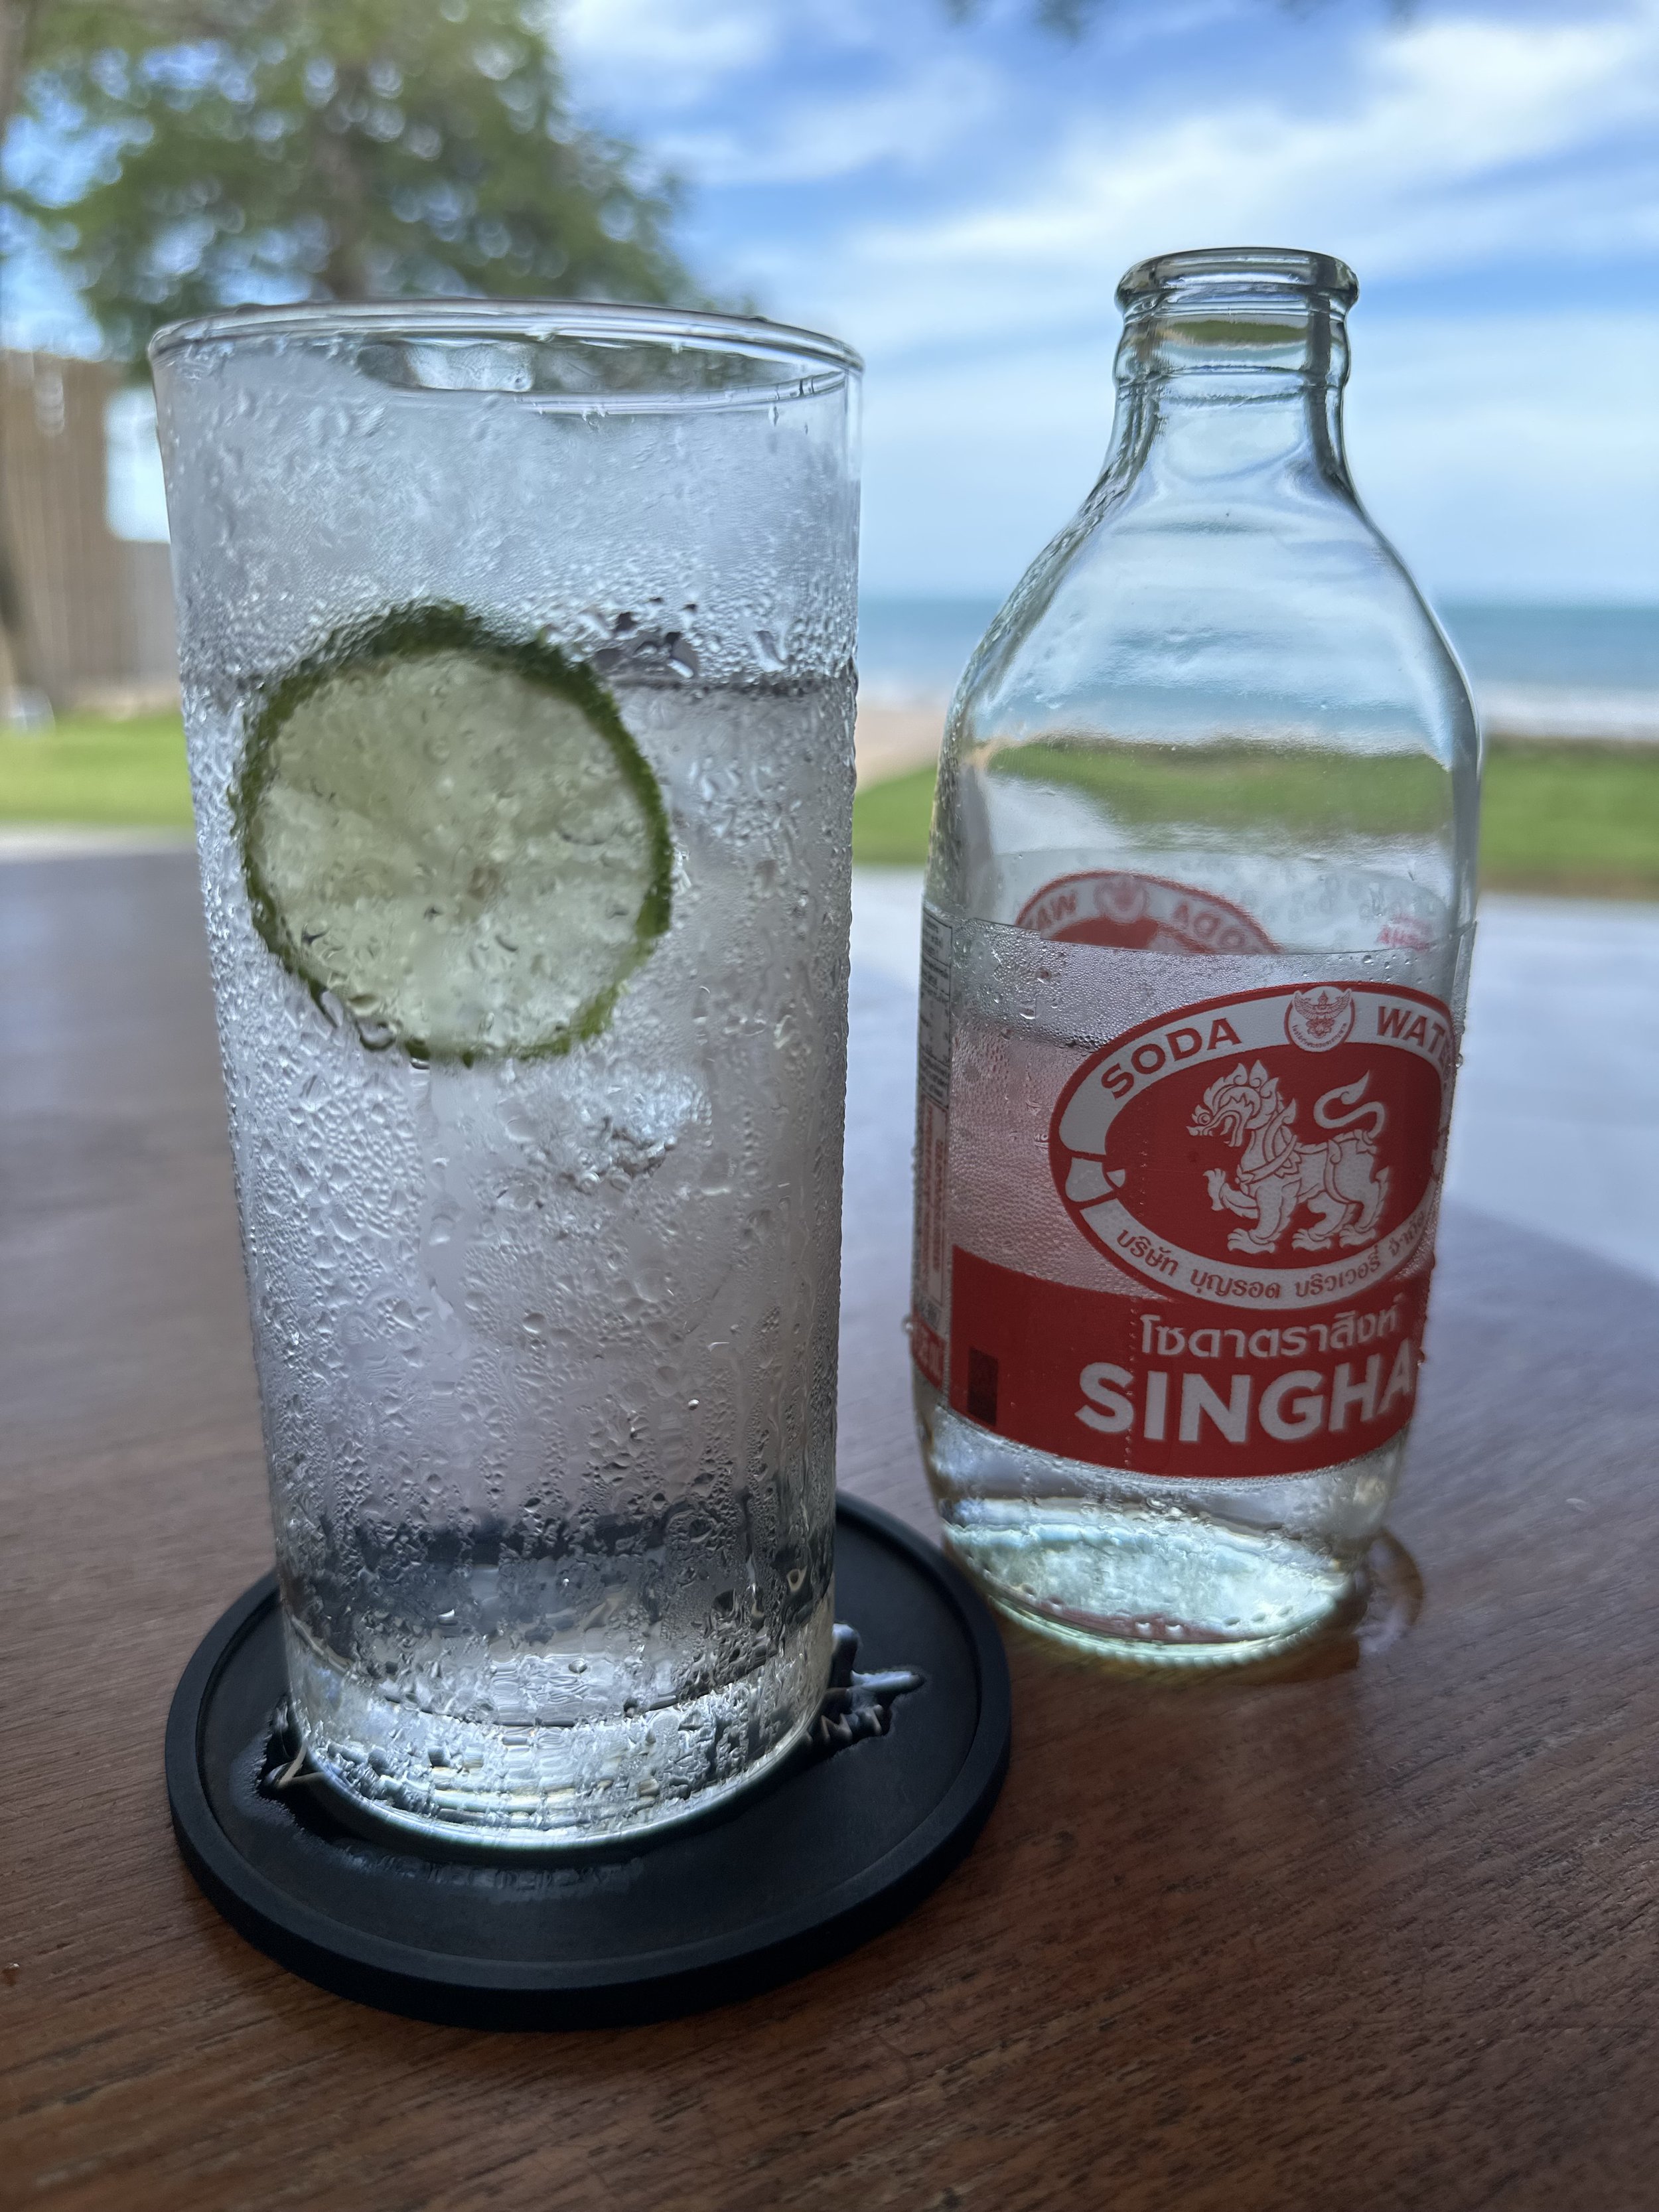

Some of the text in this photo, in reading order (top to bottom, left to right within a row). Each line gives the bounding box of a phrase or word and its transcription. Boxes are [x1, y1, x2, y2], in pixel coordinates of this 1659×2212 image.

[1101, 1017, 1242, 1100] SODA
[1117, 1229, 1179, 1277] บริษัท
[1190, 1269, 1281, 1298] บุญรอด
[1140, 1292, 1405, 1359] โซดาตราสิงห์
[1074, 1338, 1415, 1443] SINGHA
